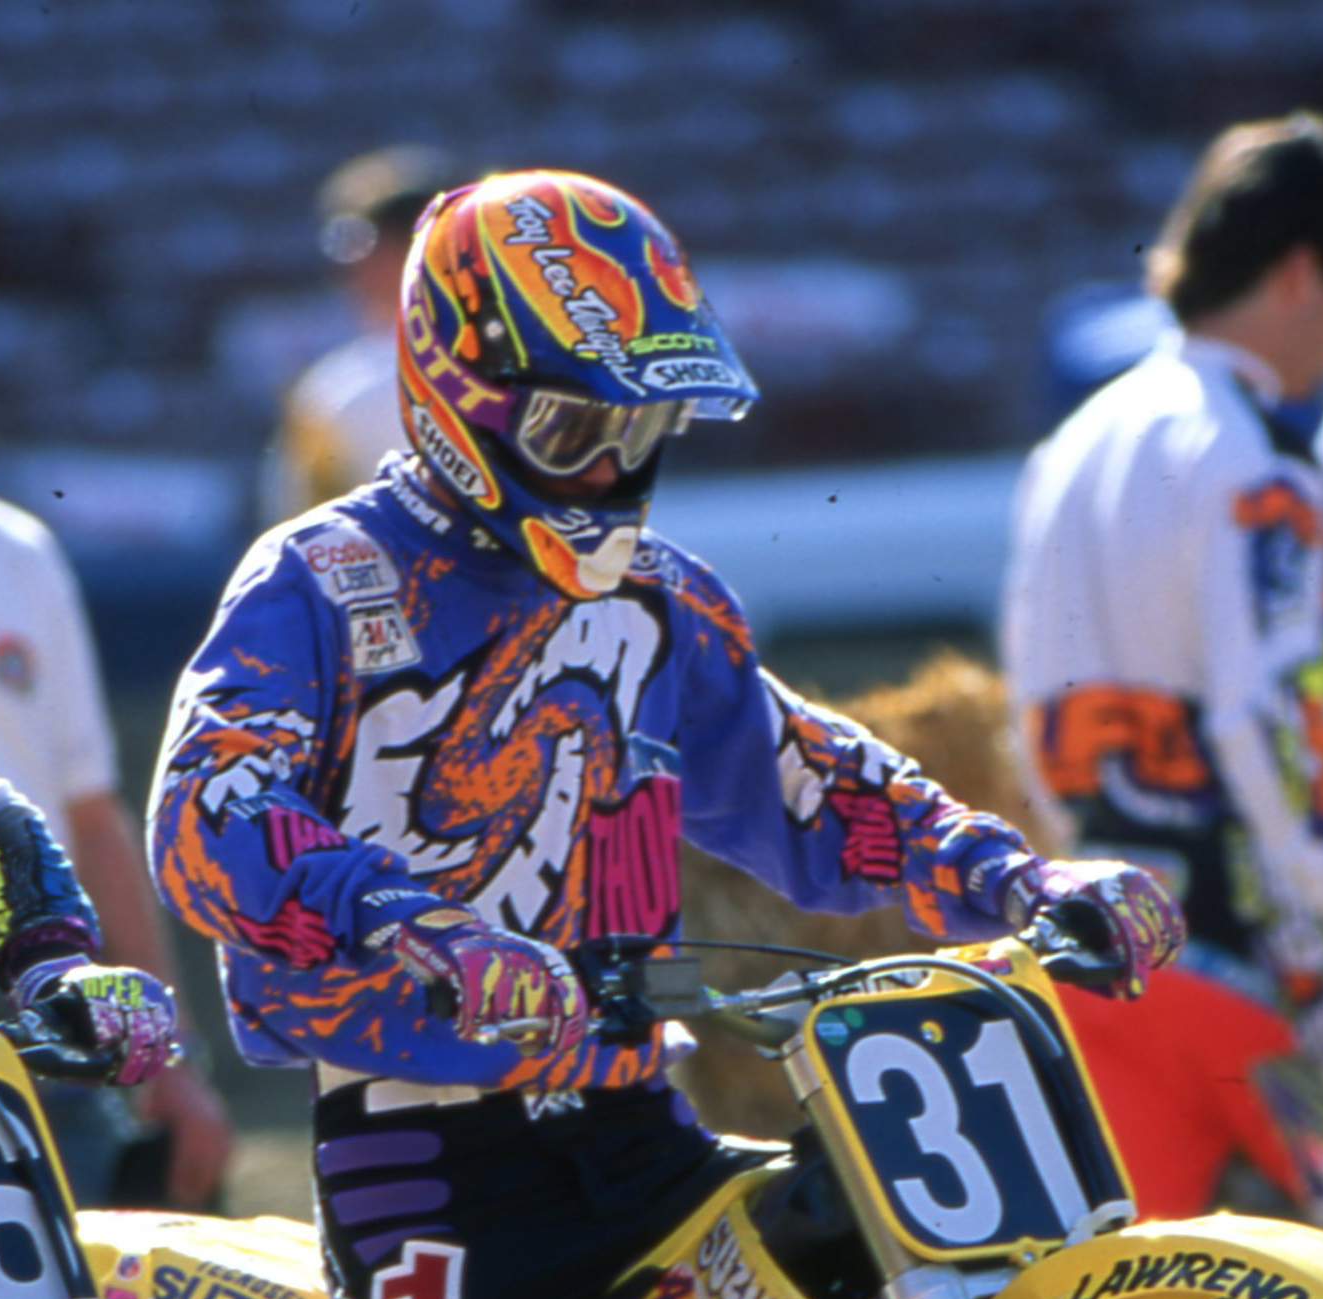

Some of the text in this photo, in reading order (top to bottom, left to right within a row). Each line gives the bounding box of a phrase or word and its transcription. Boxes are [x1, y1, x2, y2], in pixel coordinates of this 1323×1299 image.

[504, 196, 553, 246] Troy
[533, 247, 576, 297] Lee
[407, 270, 505, 412] OTT
[629, 333, 716, 356] SCOTT
[654, 360, 736, 388] SHOEI
[414, 413, 478, 491] SHOEI
[846, 1018, 1088, 1244] 31
